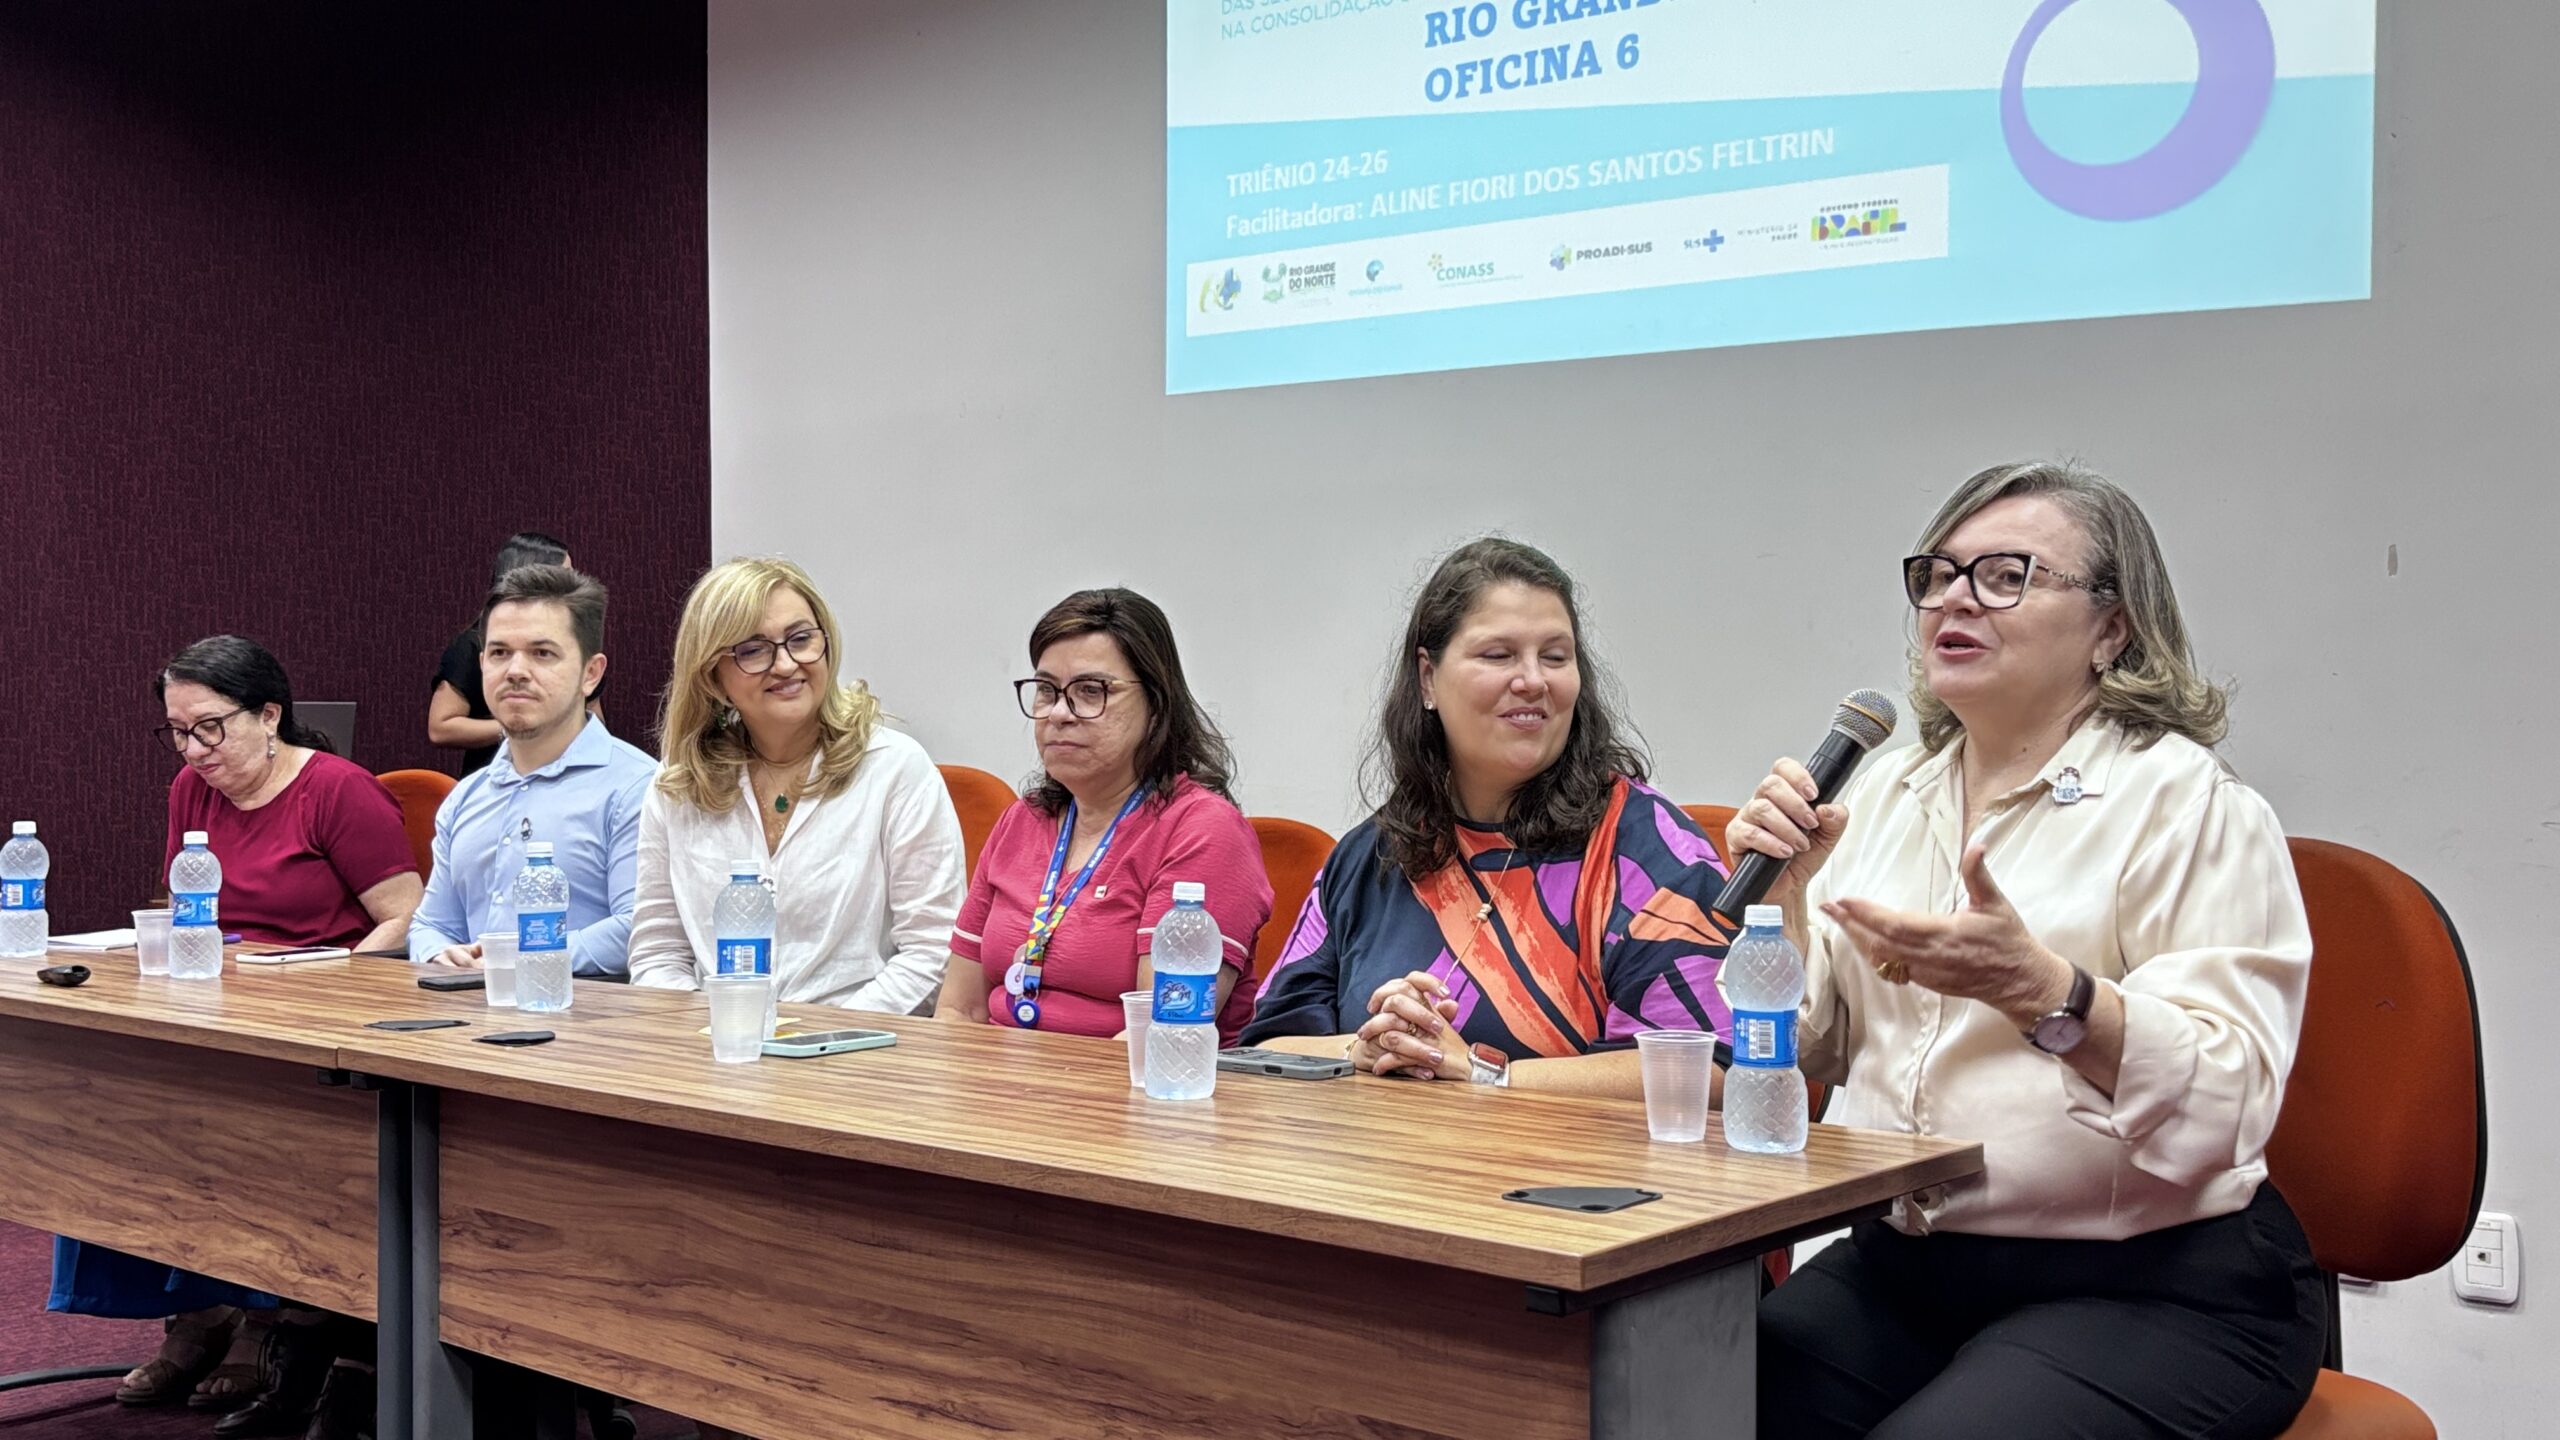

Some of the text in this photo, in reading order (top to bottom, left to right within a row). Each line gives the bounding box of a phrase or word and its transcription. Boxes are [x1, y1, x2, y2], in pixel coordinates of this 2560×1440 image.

[1221, 20, 1245, 40] NA
[1425, 0, 1662, 48] RIO GRA
[1425, 33, 1640, 102] OFICINA 6
[1226, 149, 1389, 198] TRIÊNIO 24-26
[1226, 127, 1835, 239] Facilitadora: ALINE FIORI DOS SANTOS FELTRIN
[1811, 207, 1907, 241] BRASIL
[1576, 241, 1653, 261] PROADI-SUS
[1289, 261, 1336, 277] RIO GRANDE
[1289, 272, 1336, 290] DO NORTE
[1437, 262, 1495, 281] CONASS
